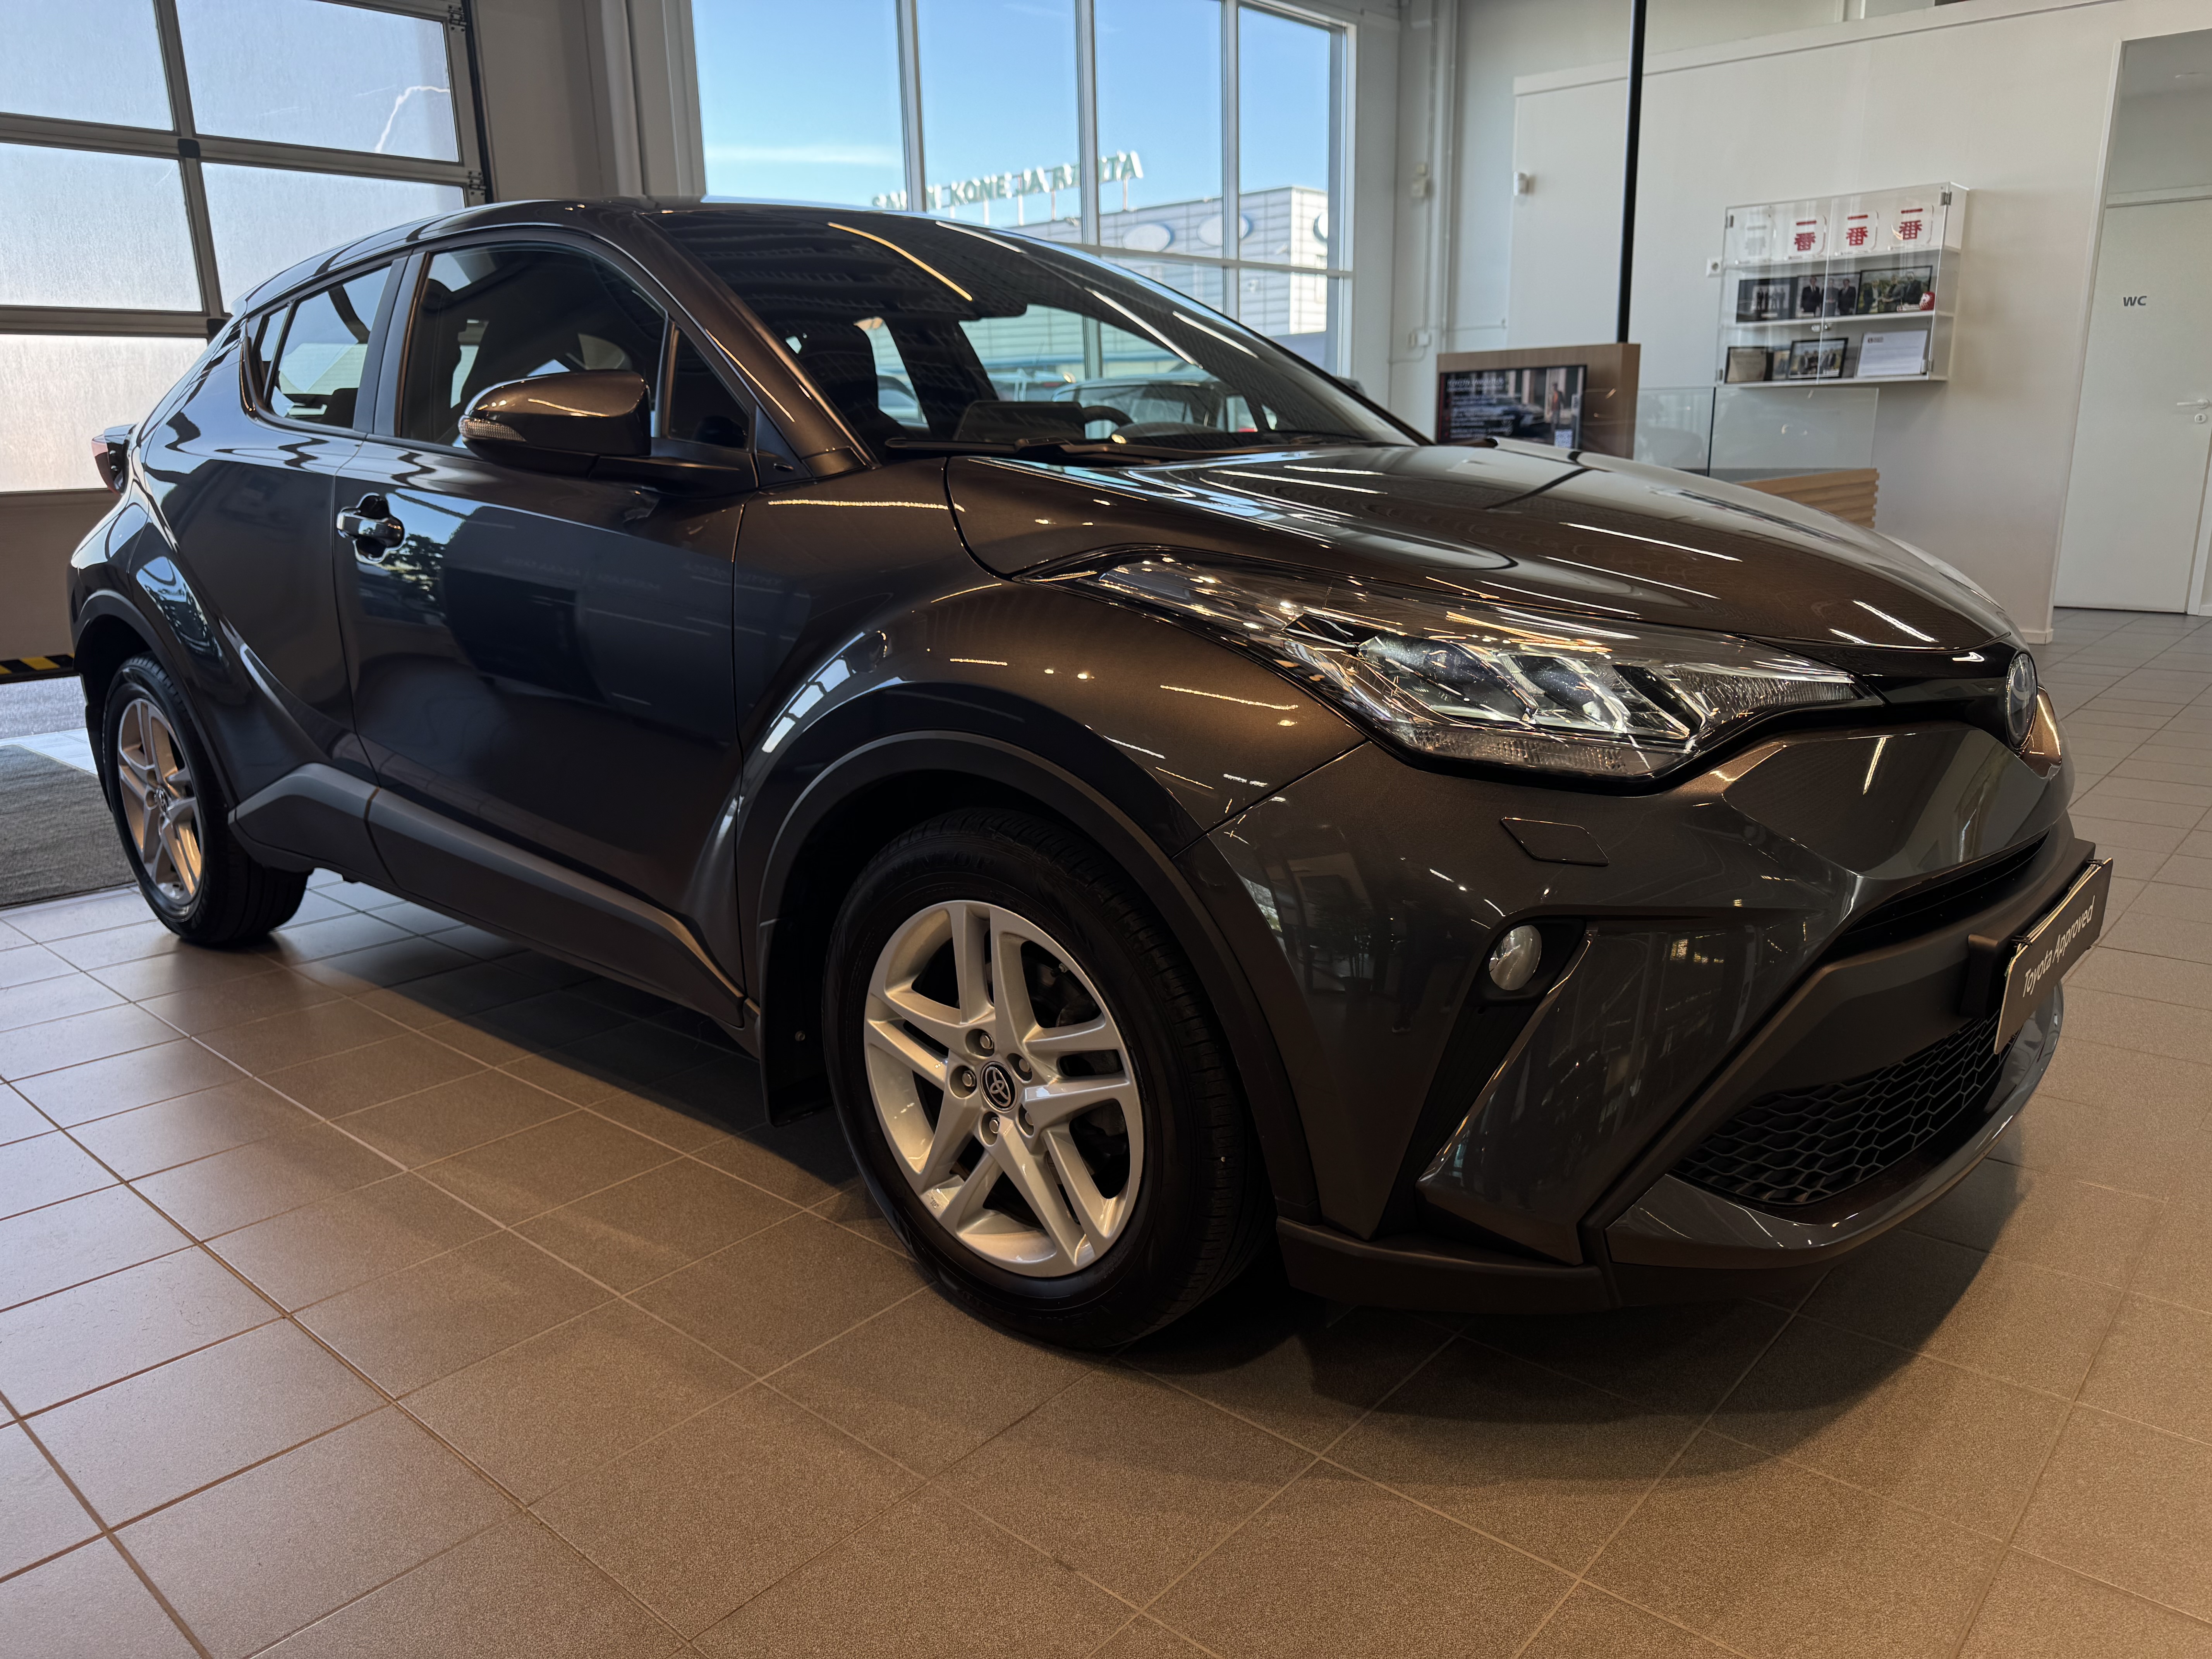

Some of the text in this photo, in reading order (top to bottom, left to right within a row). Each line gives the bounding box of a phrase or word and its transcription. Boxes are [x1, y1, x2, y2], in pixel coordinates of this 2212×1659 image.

[950, 172, 1012, 206] KONE
[2123, 295, 2147, 307] WC
[884, 850, 998, 888] DUNLOP
[2023, 895, 2095, 998] Toyota Approved
